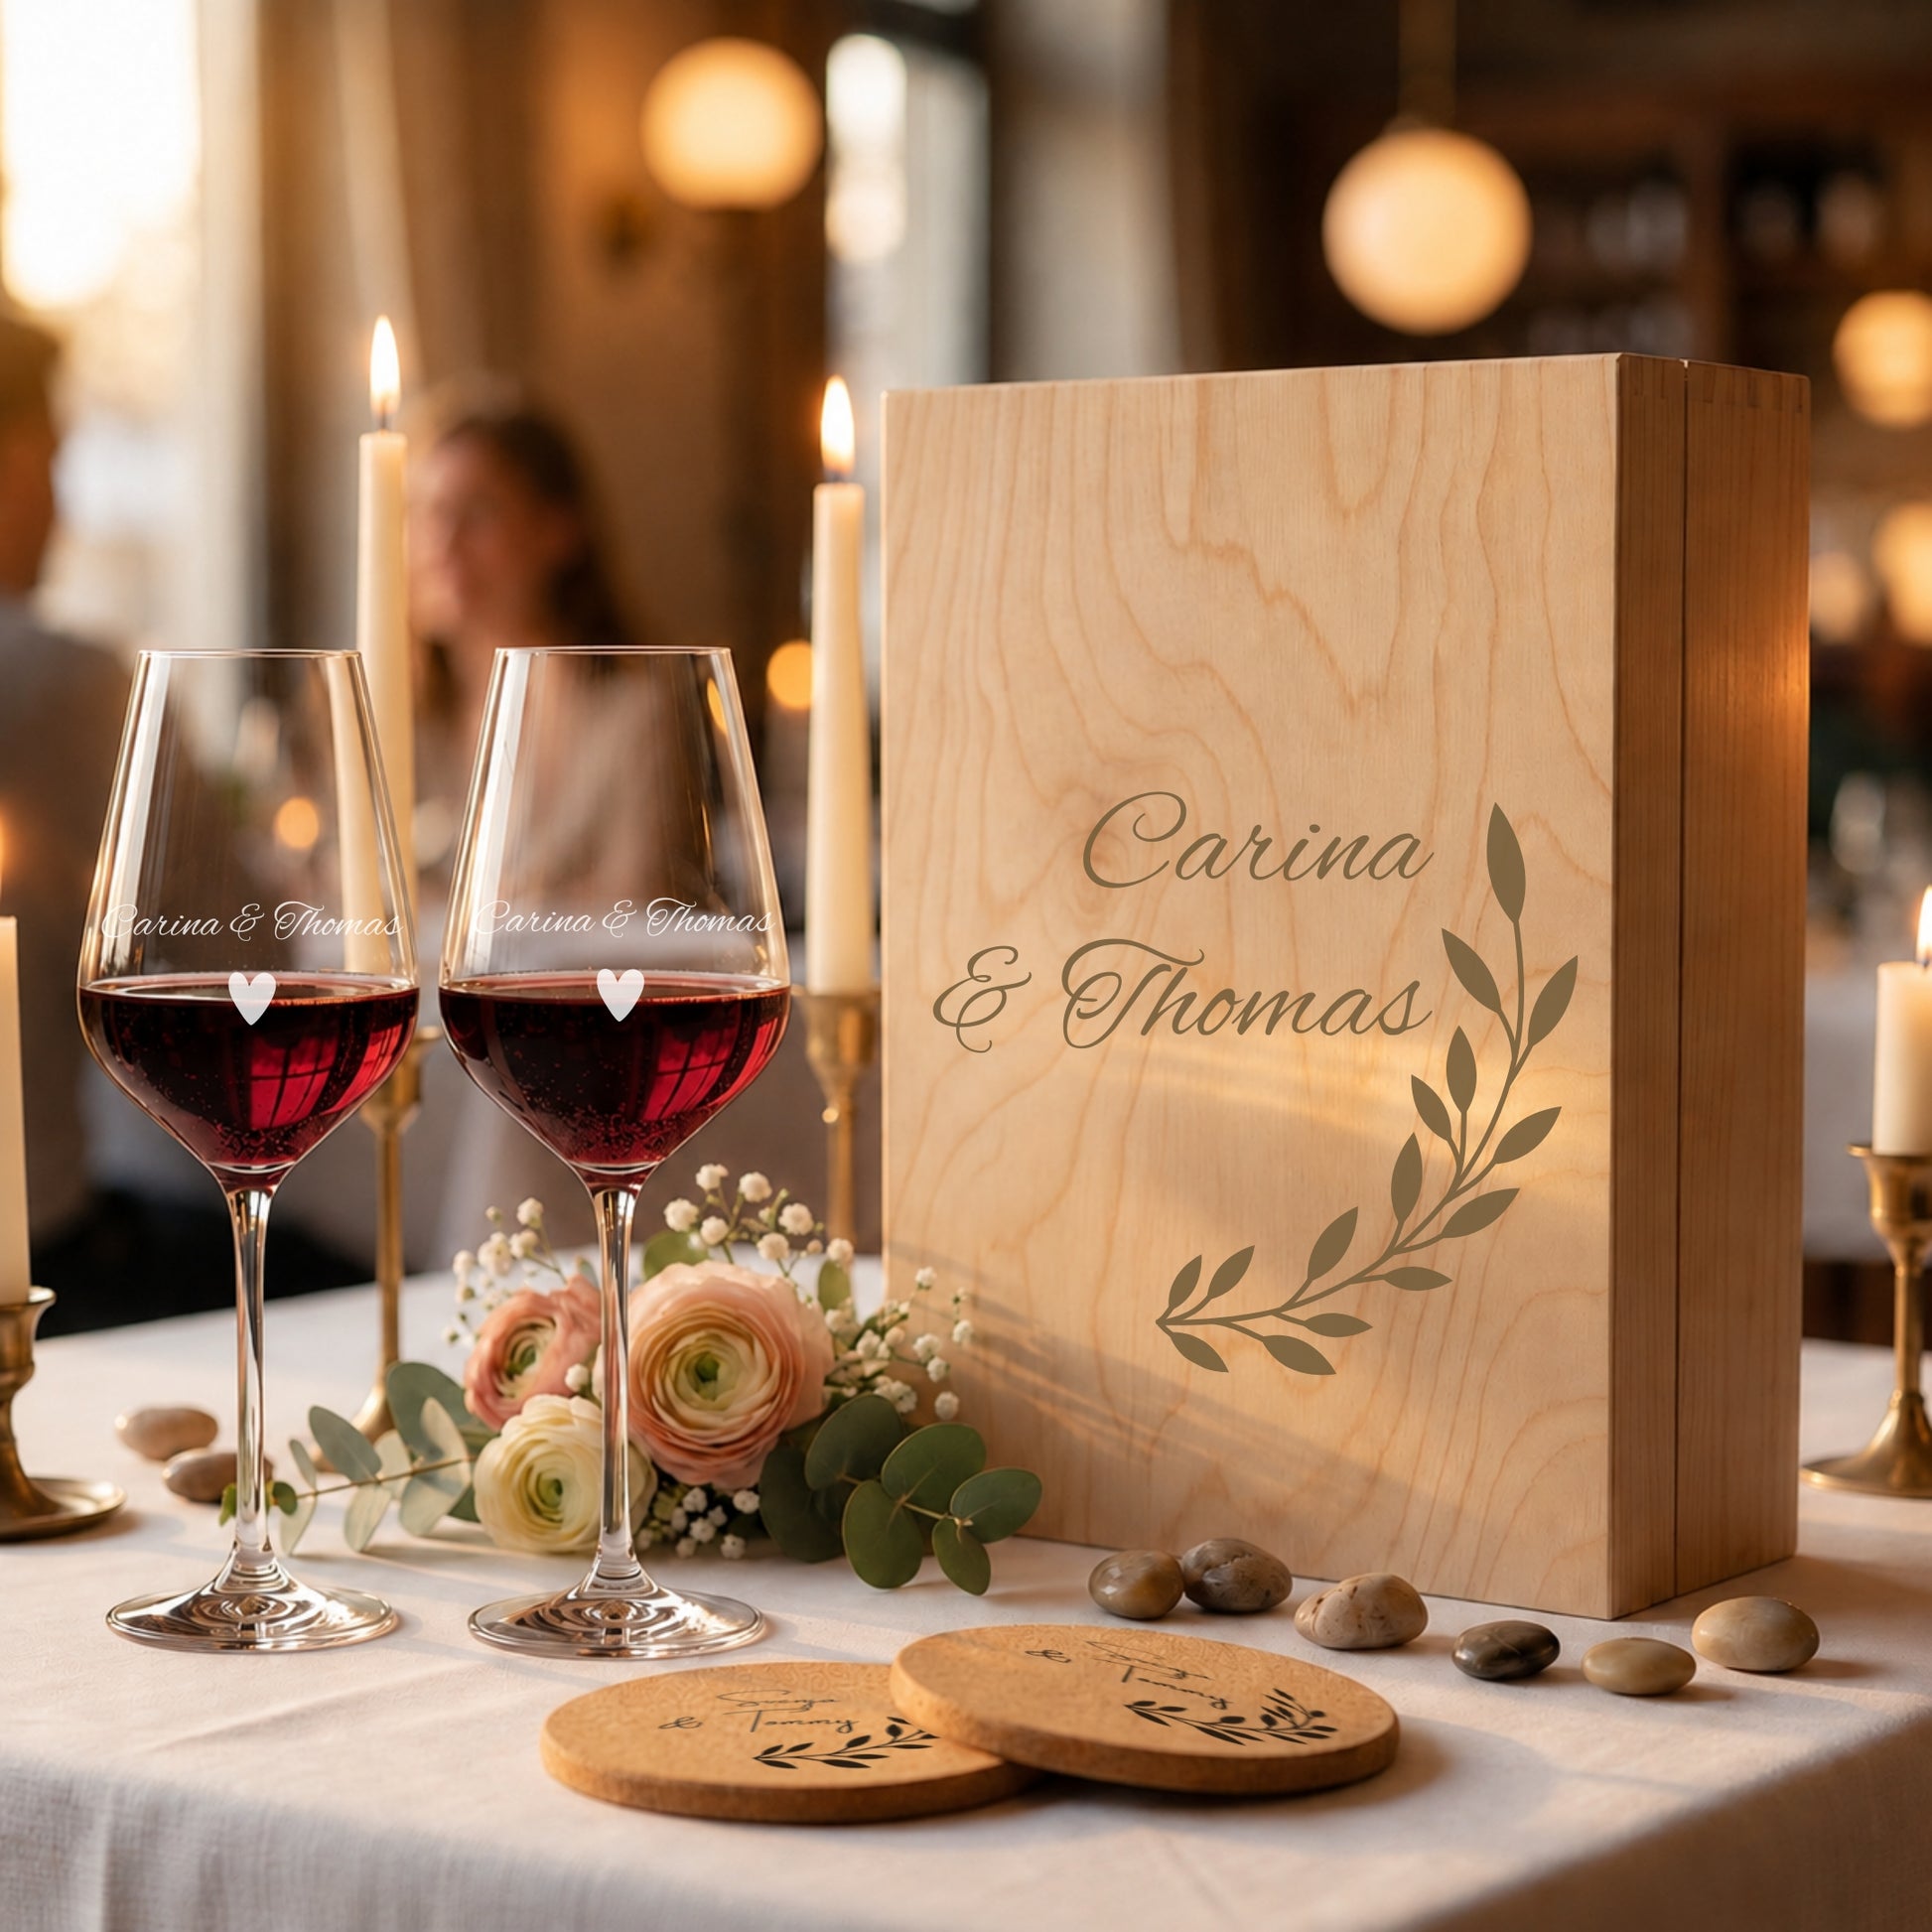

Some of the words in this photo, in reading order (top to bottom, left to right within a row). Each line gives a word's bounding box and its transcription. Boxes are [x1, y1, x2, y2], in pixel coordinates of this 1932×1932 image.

[1082, 791, 1435, 890] Carina
[101, 903, 224, 939] Carina
[229, 902, 265, 942] &
[273, 900, 405, 940] Thomas
[475, 899, 597, 935] Carina
[602, 899, 637, 938] &
[646, 897, 776, 937] Thomas
[932, 945, 1033, 1054] &
[1061, 938, 1434, 1049] Thomas
